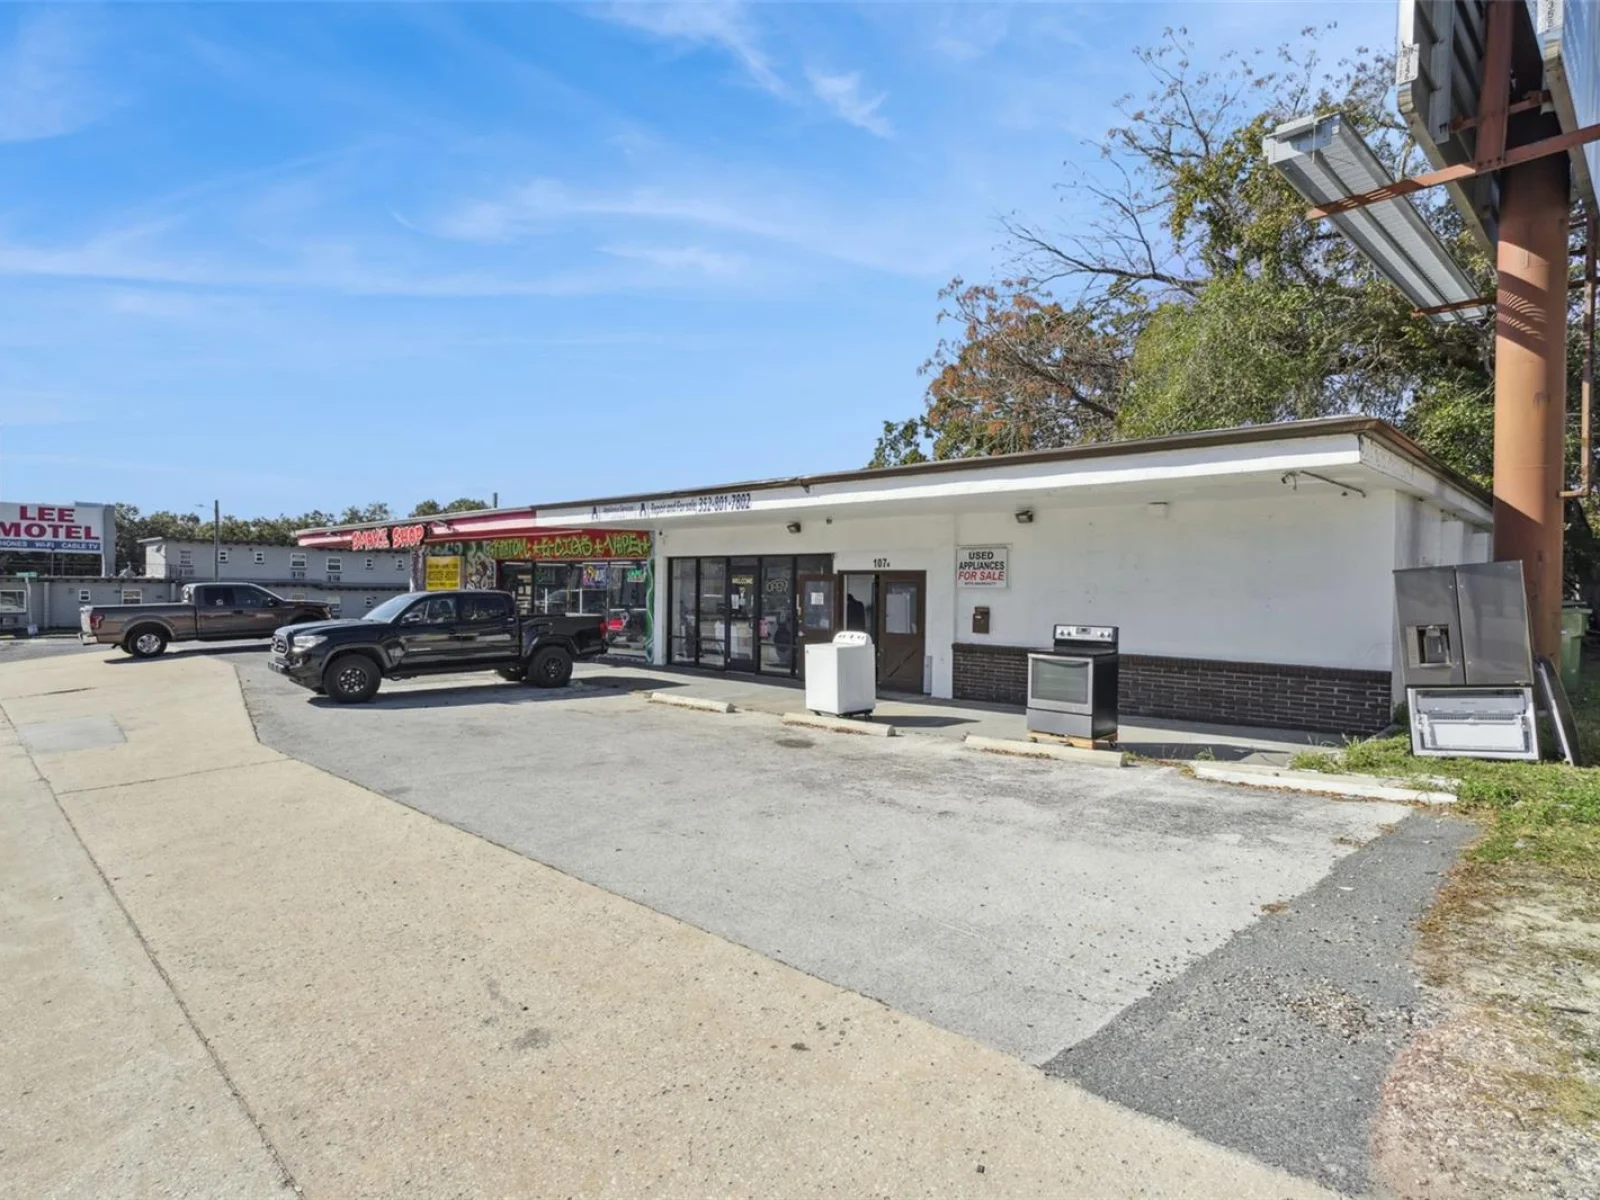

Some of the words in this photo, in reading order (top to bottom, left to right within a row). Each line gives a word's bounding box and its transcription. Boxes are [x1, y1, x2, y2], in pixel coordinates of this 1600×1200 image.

[20, 505, 75, 523] LEE
[0, 521, 100, 540] MOTEL
[352, 528, 390, 550] SMOKE
[392, 524, 423, 548] SHOP
[968, 551, 994, 560] USED
[959, 561, 1005, 570] APPLIANCES
[958, 571, 978, 580] FOR
[979, 571, 1005, 581] SALE
